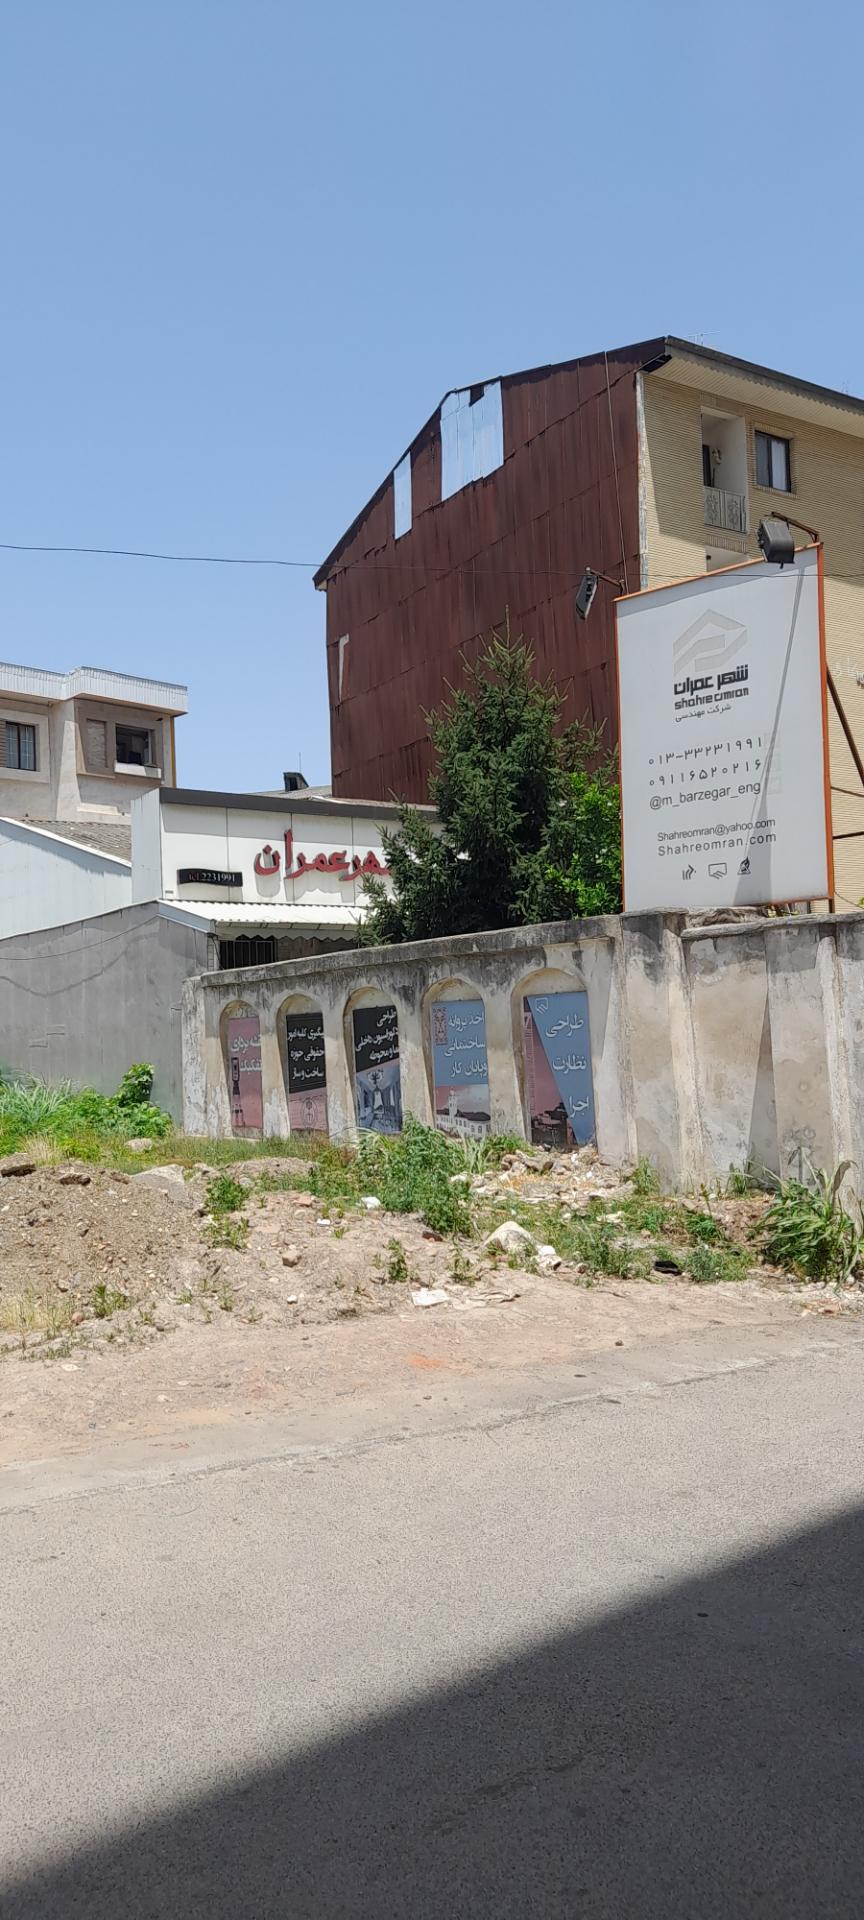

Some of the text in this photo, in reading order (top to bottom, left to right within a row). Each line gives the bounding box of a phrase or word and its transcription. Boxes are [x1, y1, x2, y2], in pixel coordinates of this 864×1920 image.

[673, 664, 749, 696] شهر عمران
[674, 694, 713, 710] shahre
[675, 703, 732, 723] شرکت مهندسی
[649, 758, 762, 786] ۰۹۱۱۶۵۲۰۲۱۶
[649, 782, 762, 810] @m_barzegar_eng
[254, 828, 394, 882] هر عمران
[658, 833, 777, 857] Shahreomran.com
[376, 1008, 397, 1027] طراحی
[545, 1013, 584, 1038] طراحی
[444, 1035, 486, 1057] ساختمانی
[552, 1055, 587, 1074] نظارت
[568, 1096, 589, 1118] اجرا
